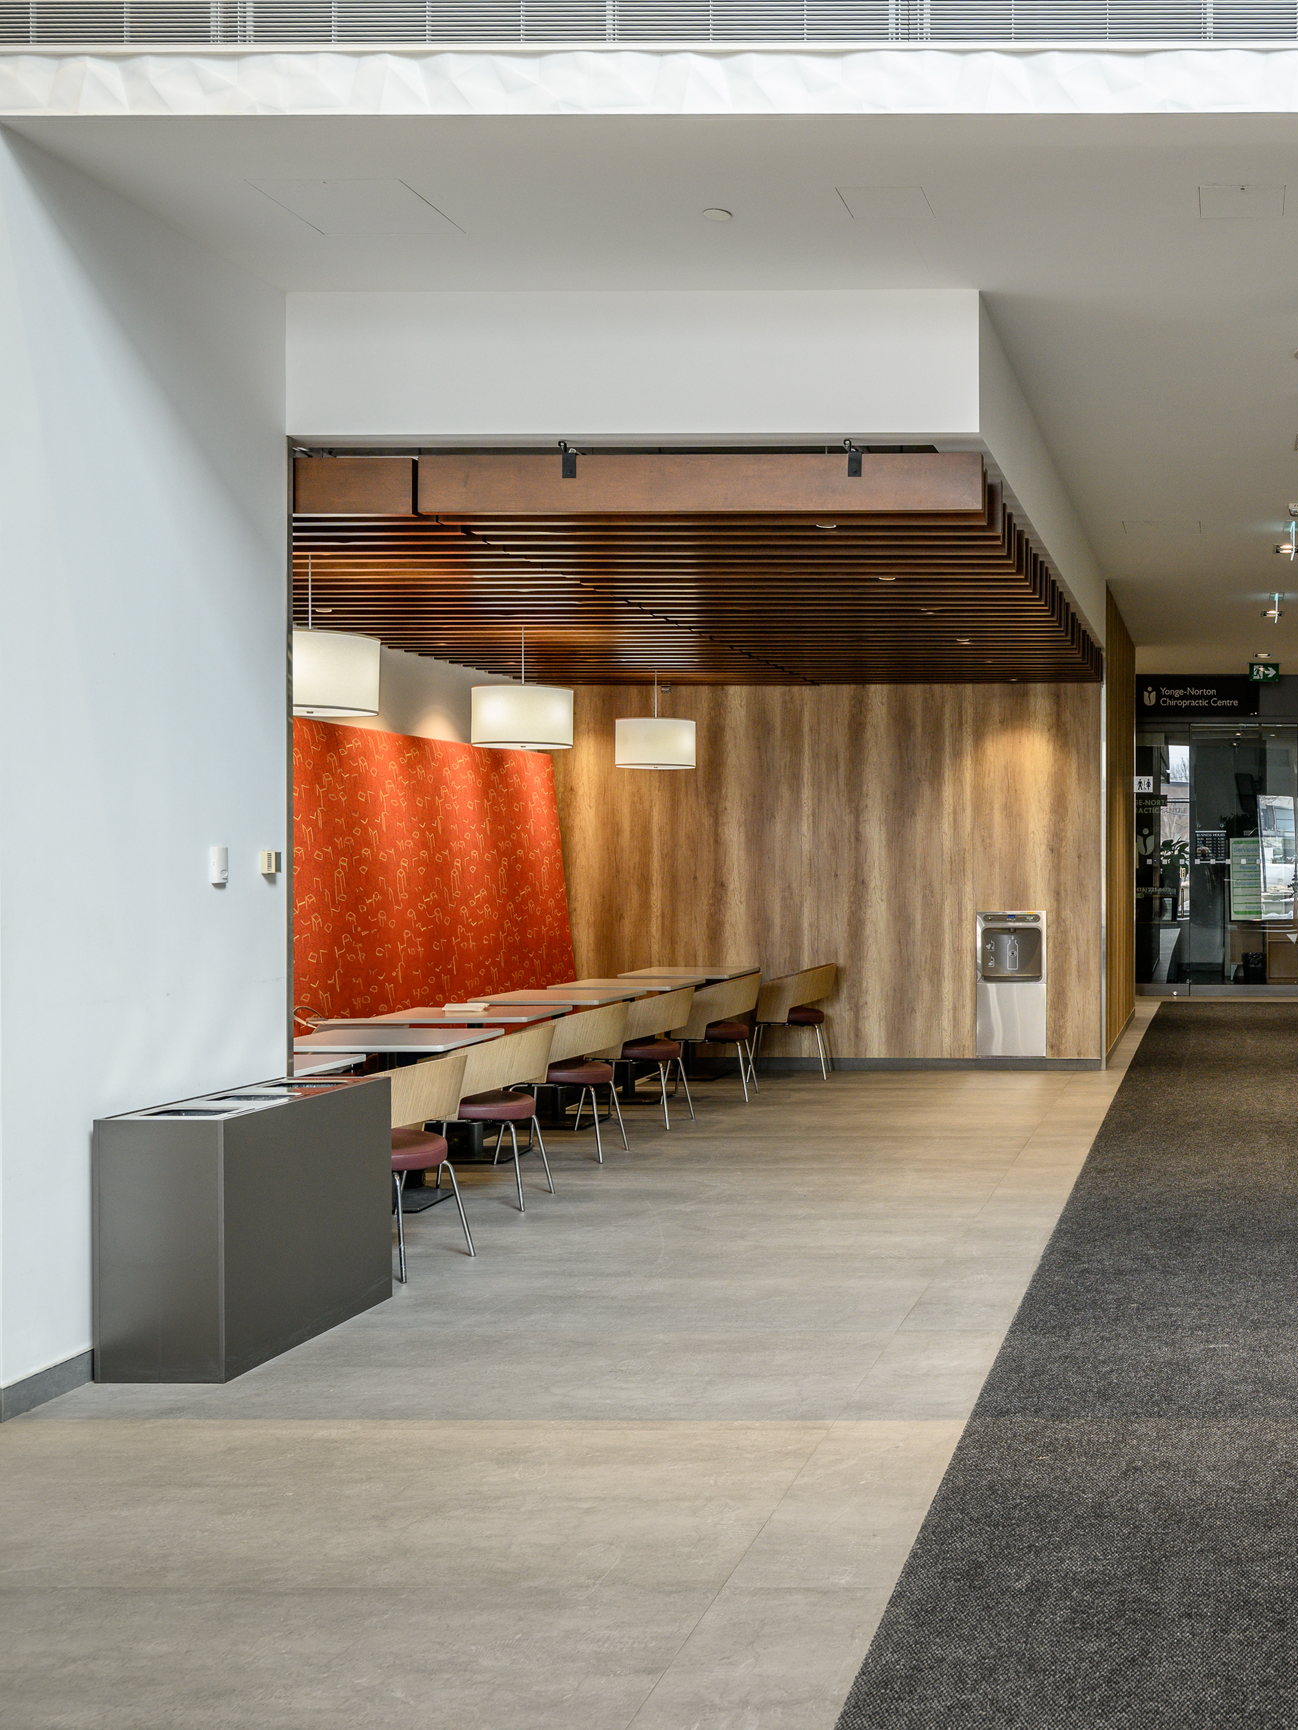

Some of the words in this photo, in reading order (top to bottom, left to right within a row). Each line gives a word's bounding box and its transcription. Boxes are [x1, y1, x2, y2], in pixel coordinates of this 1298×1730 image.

[1160, 687, 1217, 698] Yonge-Norton
[1160, 697, 1209, 708] Chiropractic
[1210, 697, 1239, 707] Centre
